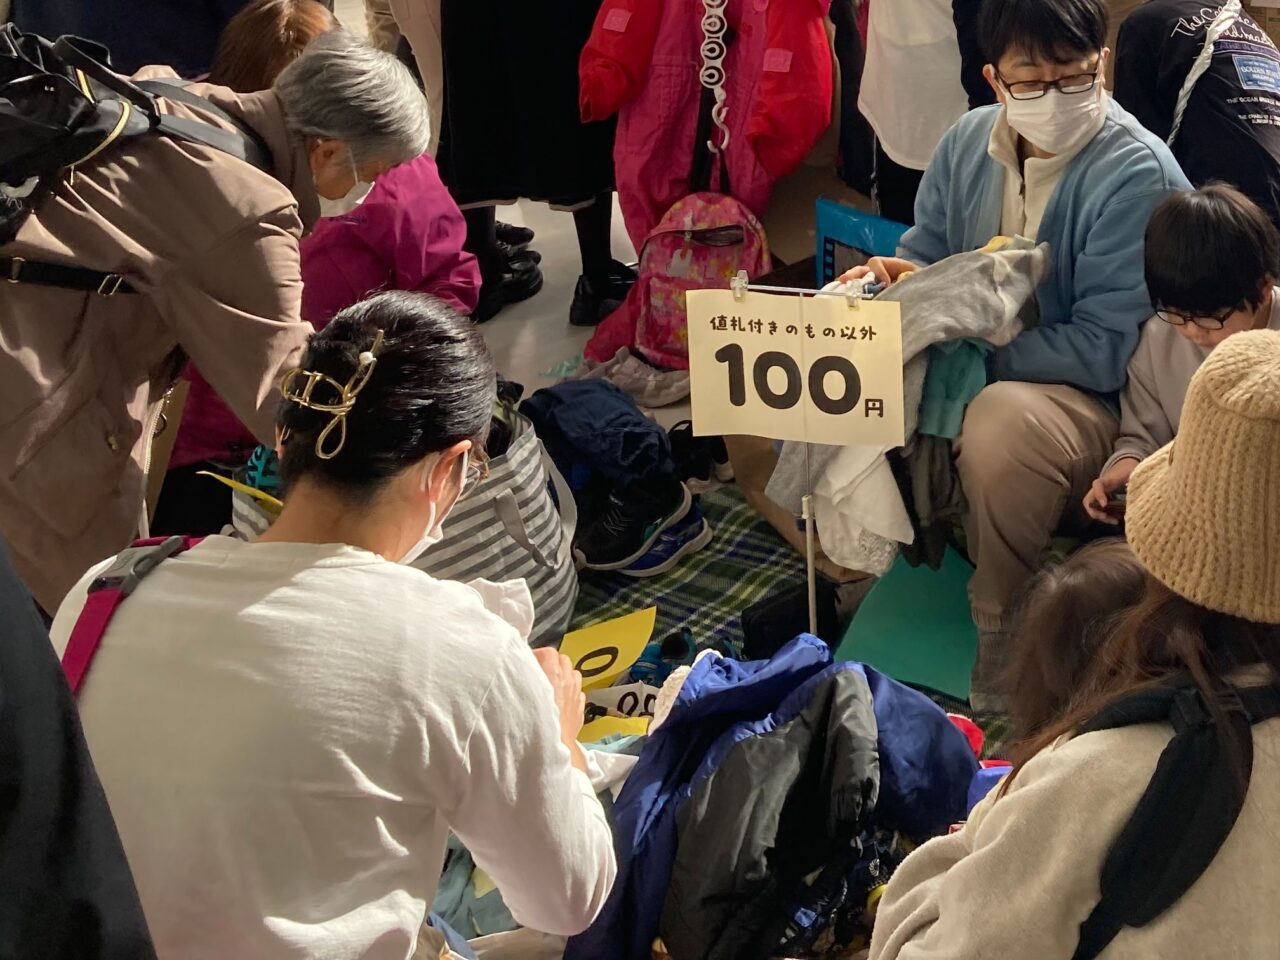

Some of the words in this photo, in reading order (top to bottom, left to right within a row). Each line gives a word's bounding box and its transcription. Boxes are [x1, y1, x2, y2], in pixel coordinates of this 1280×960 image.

[709, 314, 877, 341] 値札付きのもの以外
